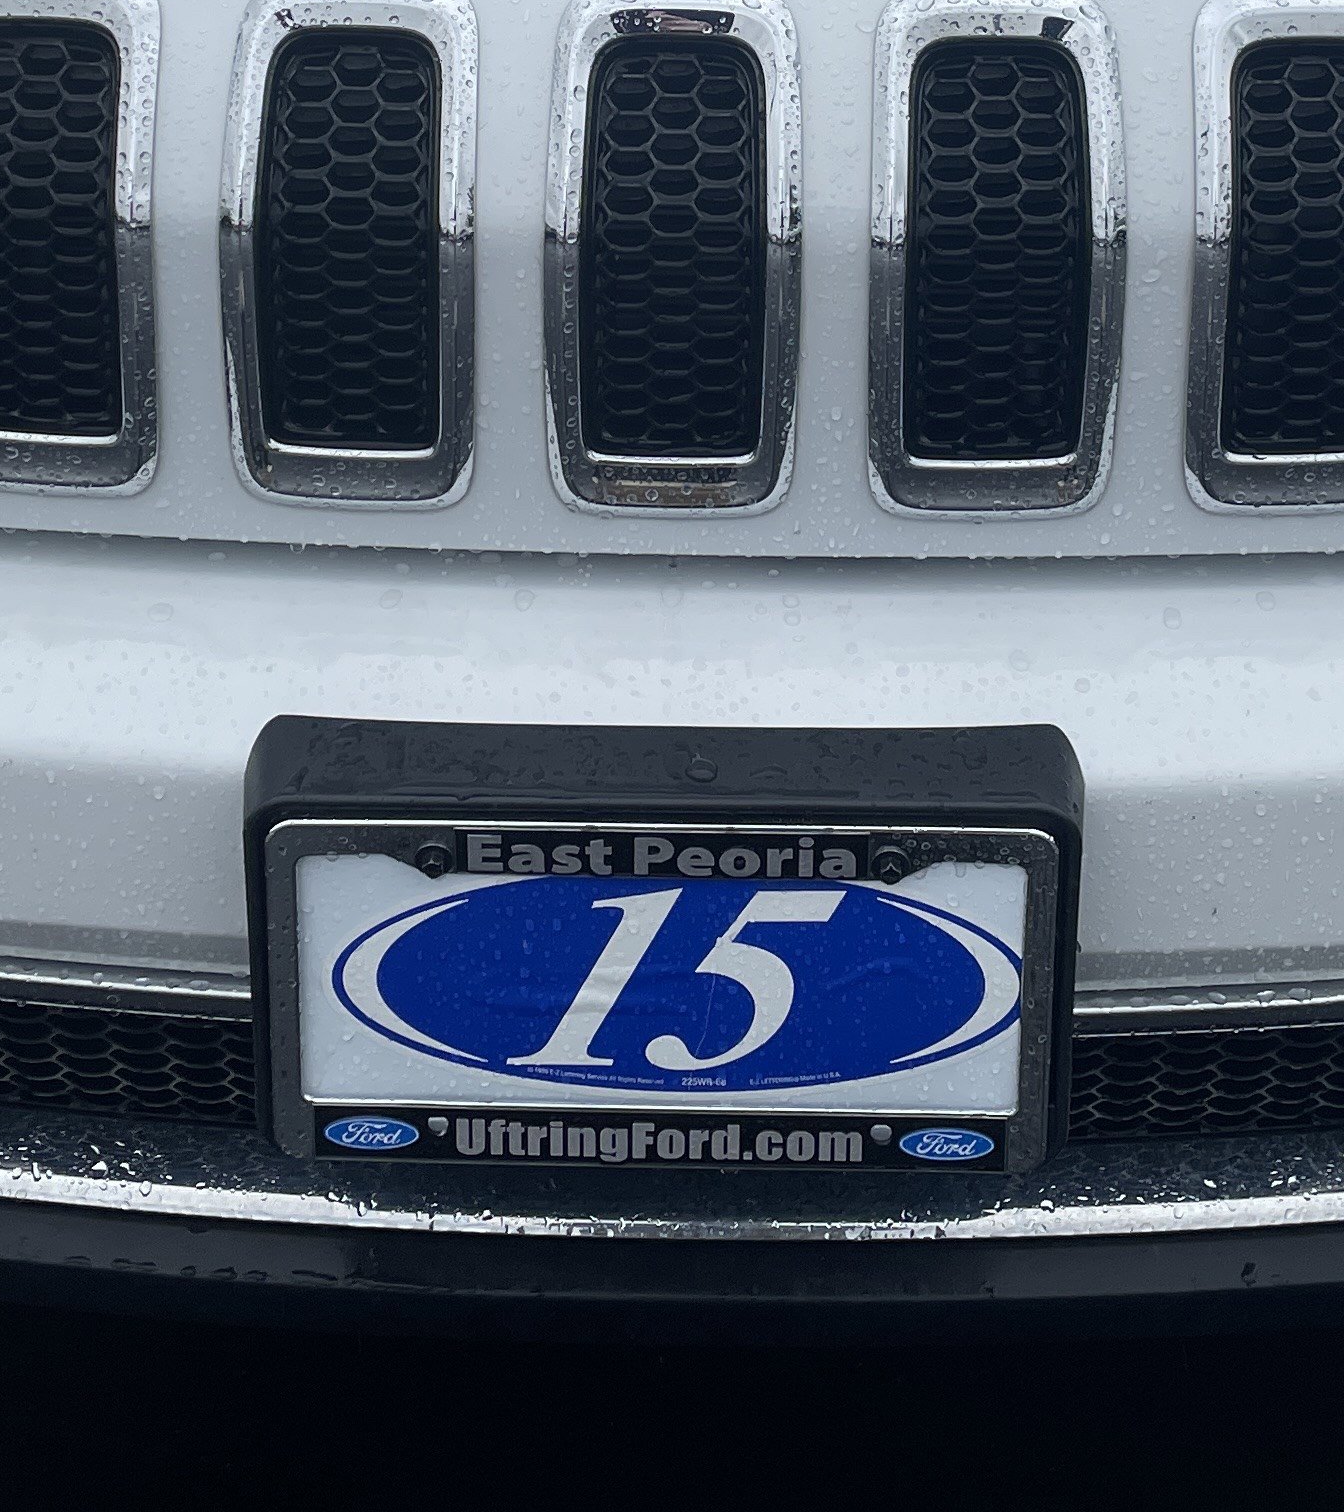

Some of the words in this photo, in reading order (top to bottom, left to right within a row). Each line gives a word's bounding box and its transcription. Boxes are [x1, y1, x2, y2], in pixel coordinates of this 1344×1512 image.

[466, 833, 613, 876] East
[633, 836, 857, 879] Peoria
[506, 887, 848, 1071] 15
[341, 1122, 402, 1145] Ford
[456, 1117, 863, 1163] UftringFord.com
[915, 1132, 977, 1156] Ford
